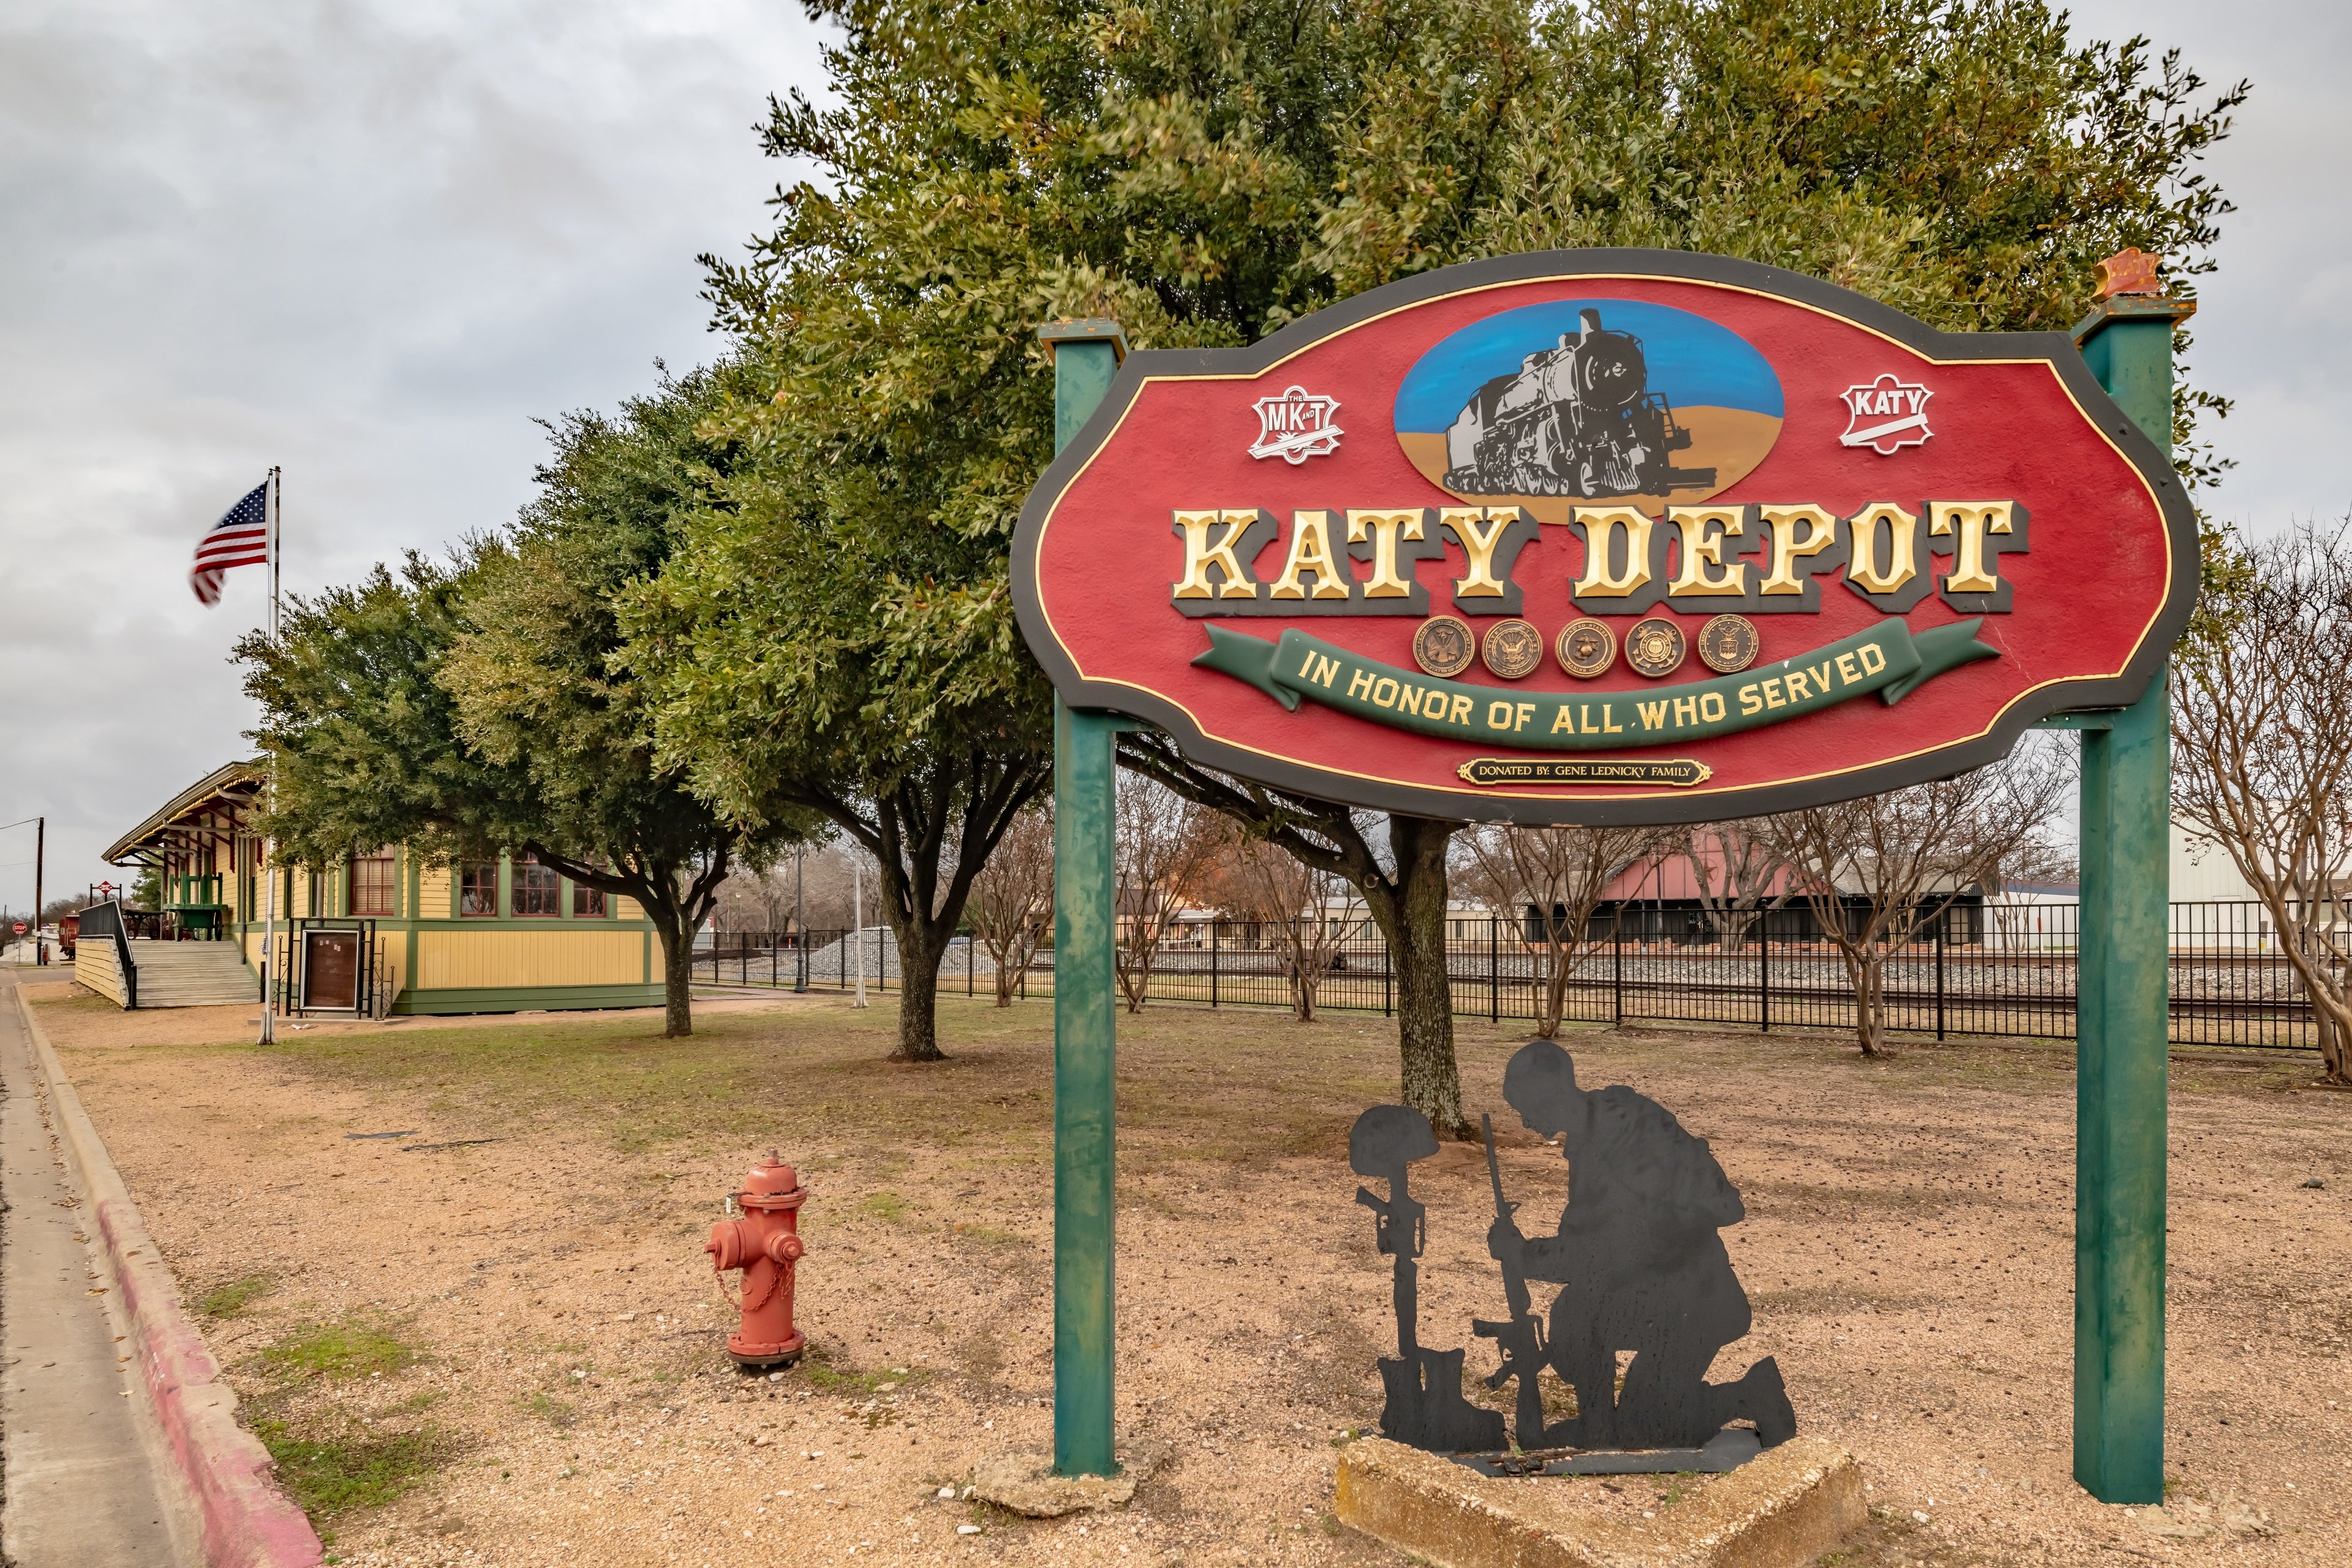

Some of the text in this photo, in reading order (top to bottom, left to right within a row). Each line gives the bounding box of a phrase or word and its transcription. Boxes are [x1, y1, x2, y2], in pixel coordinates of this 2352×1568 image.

[1855, 390, 1923, 415] KATY
[1302, 410, 1314, 421] AND
[1172, 500, 2015, 600] KATY DEPOT
[1463, 631, 1471, 645] ARMY
[1488, 628, 1503, 654] UNITED
[1589, 624, 1608, 638] STATES
[1700, 620, 1719, 646] DEPARTMENT
[1417, 649, 1429, 667] UNITED
[1455, 650, 1470, 670] AMERICA
[1567, 660, 1605, 673] MARINE CORPS
[1297, 643, 1887, 734] IN HONOR OF ALL WHO SERVED
[1479, 765, 1691, 778] DONATED BY: GENE LEDNICKY FAMILY
